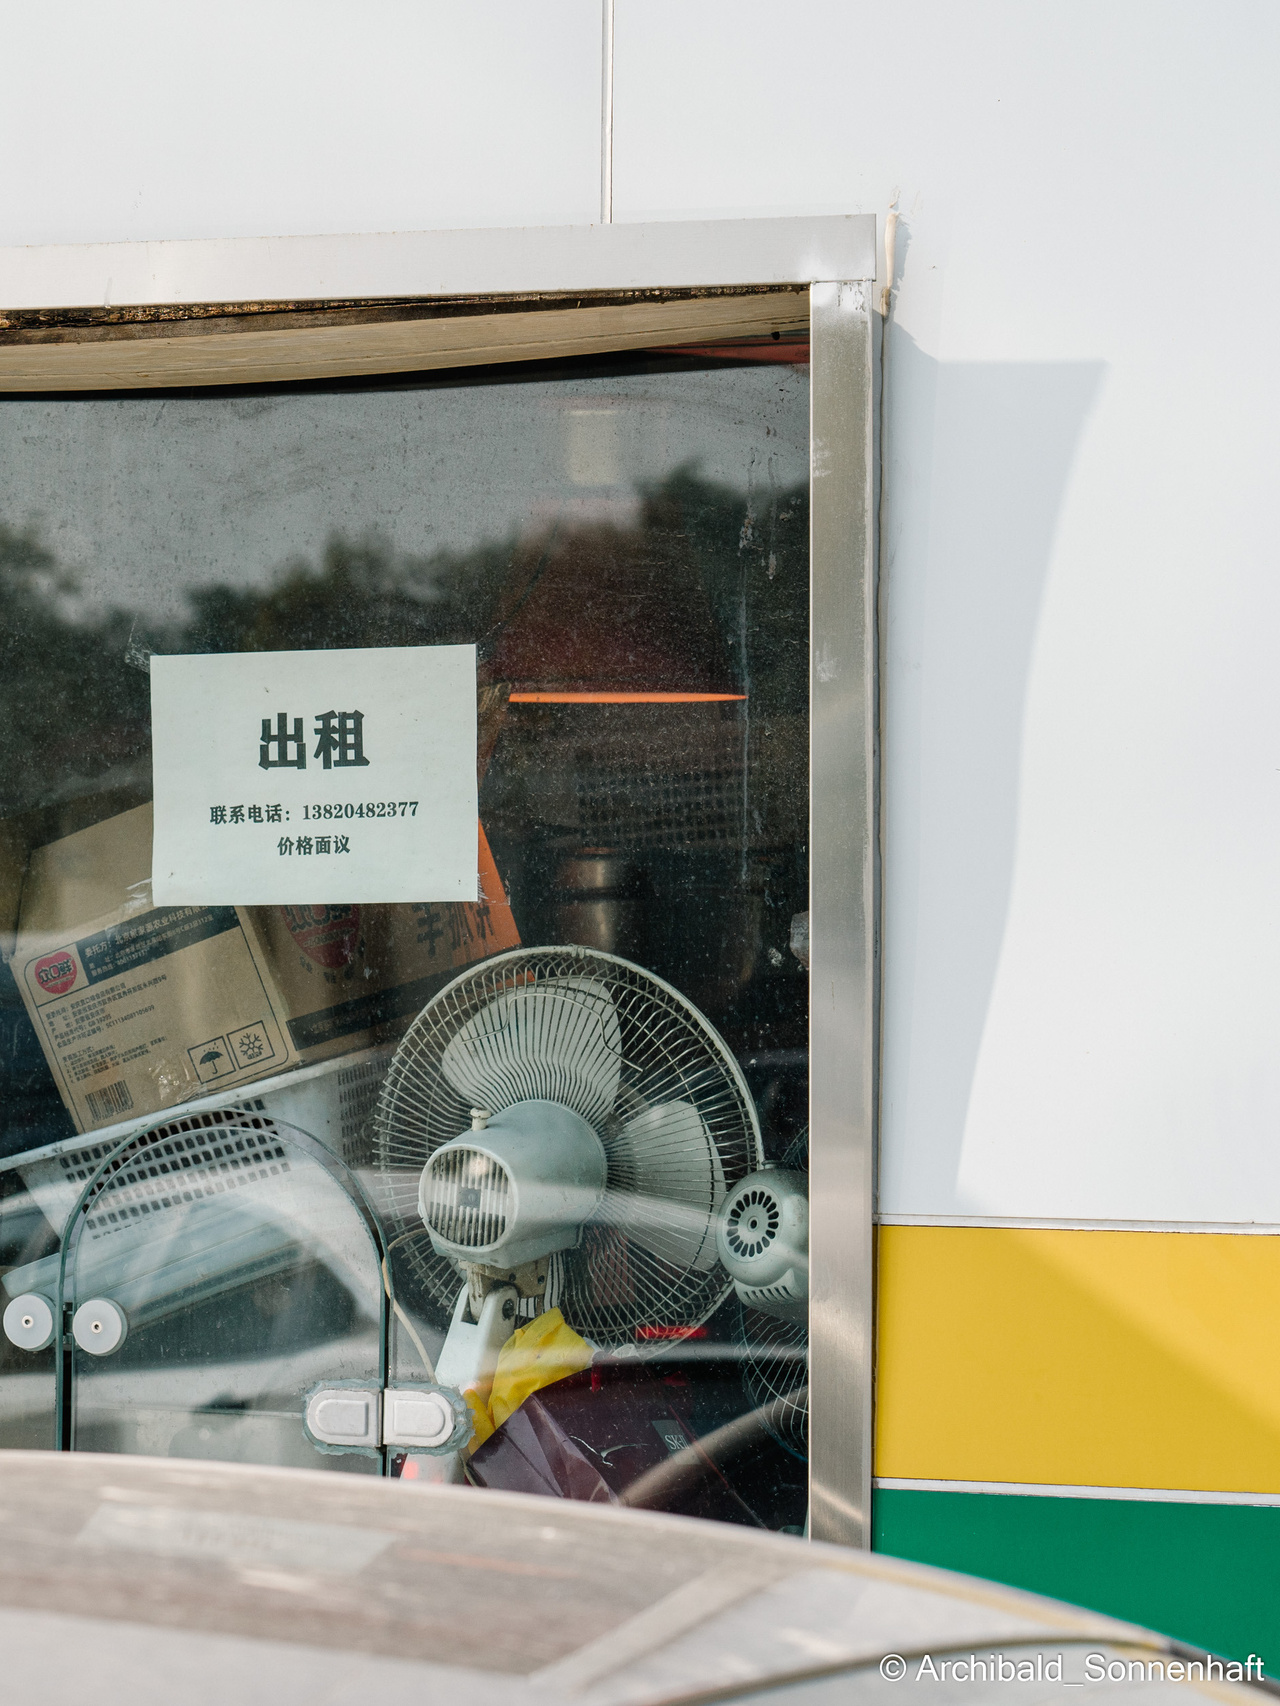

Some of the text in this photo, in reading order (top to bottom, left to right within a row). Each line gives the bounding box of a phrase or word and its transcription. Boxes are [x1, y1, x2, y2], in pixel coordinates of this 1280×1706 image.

[258, 709, 371, 771] 出租
[277, 835, 351, 856] 价格面议
